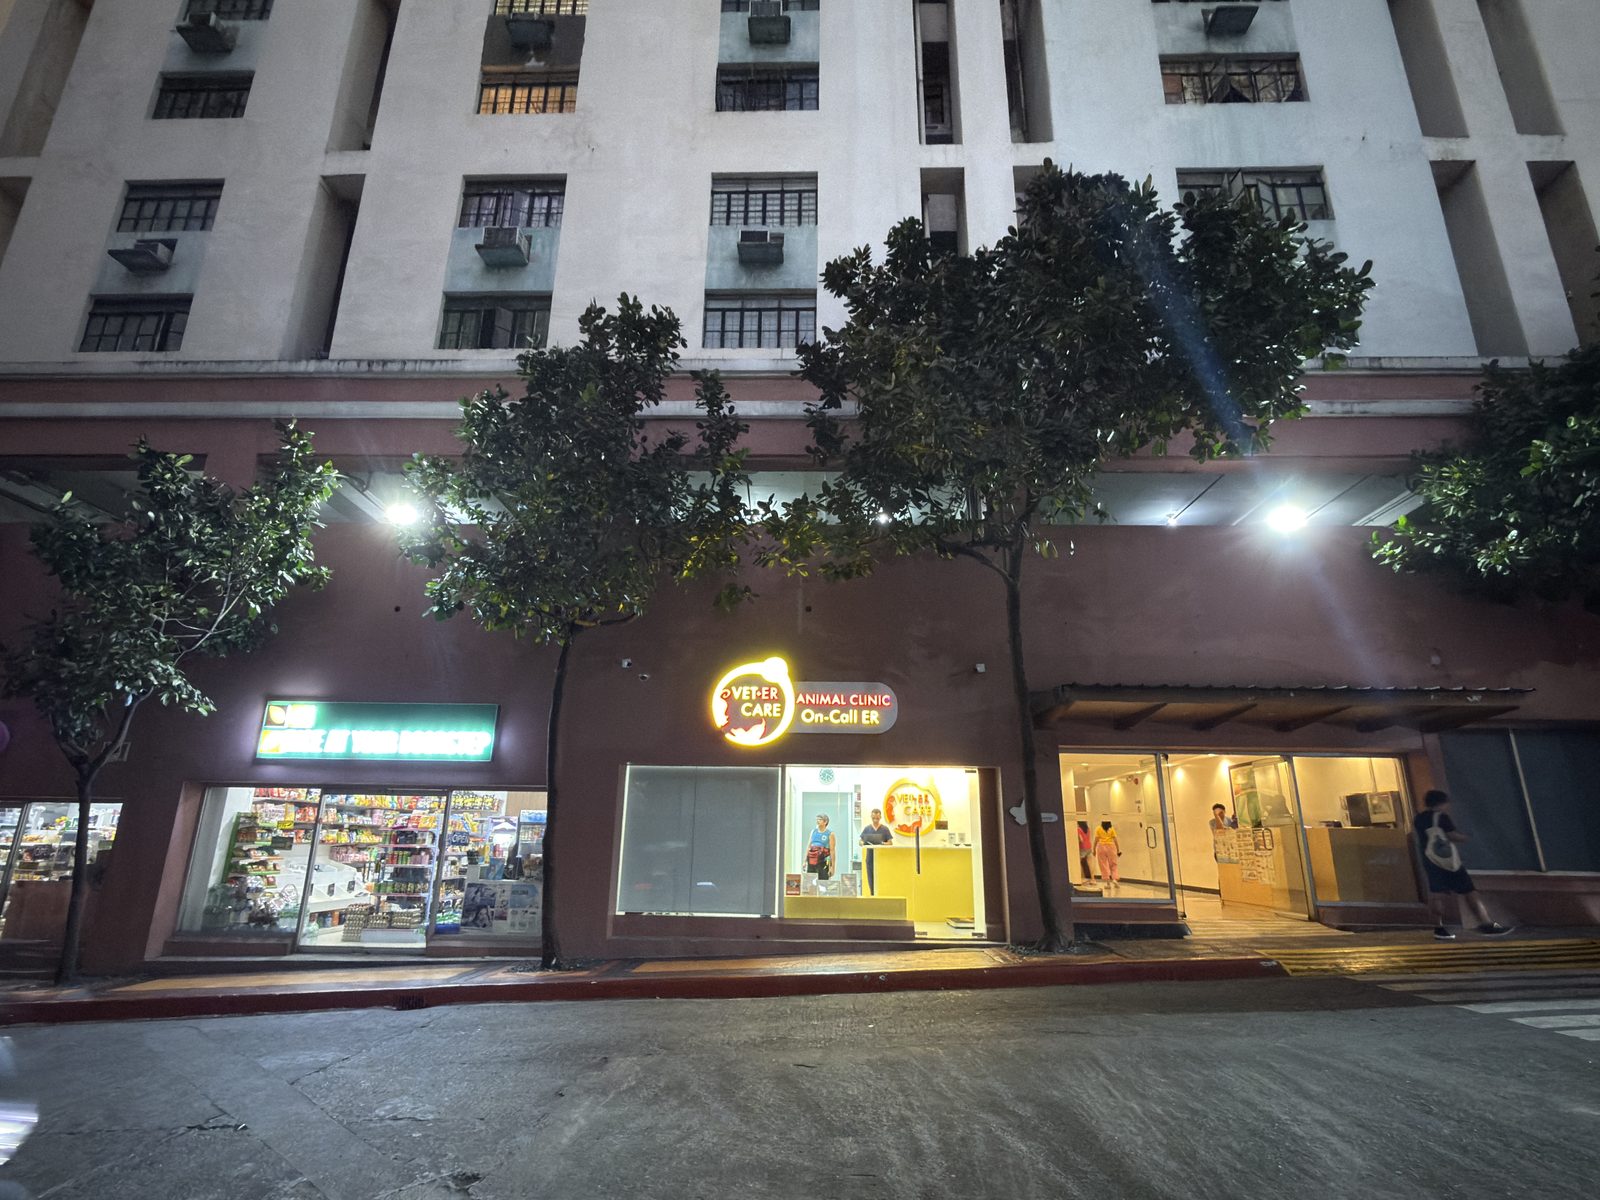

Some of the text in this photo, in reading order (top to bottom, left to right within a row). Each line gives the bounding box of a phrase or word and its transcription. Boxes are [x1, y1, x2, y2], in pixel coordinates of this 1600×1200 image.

[796, 694, 891, 706] ANIMAL CLINIC
[741, 703, 781, 717] CARE
[801, 709, 879, 724] On-Call ER
